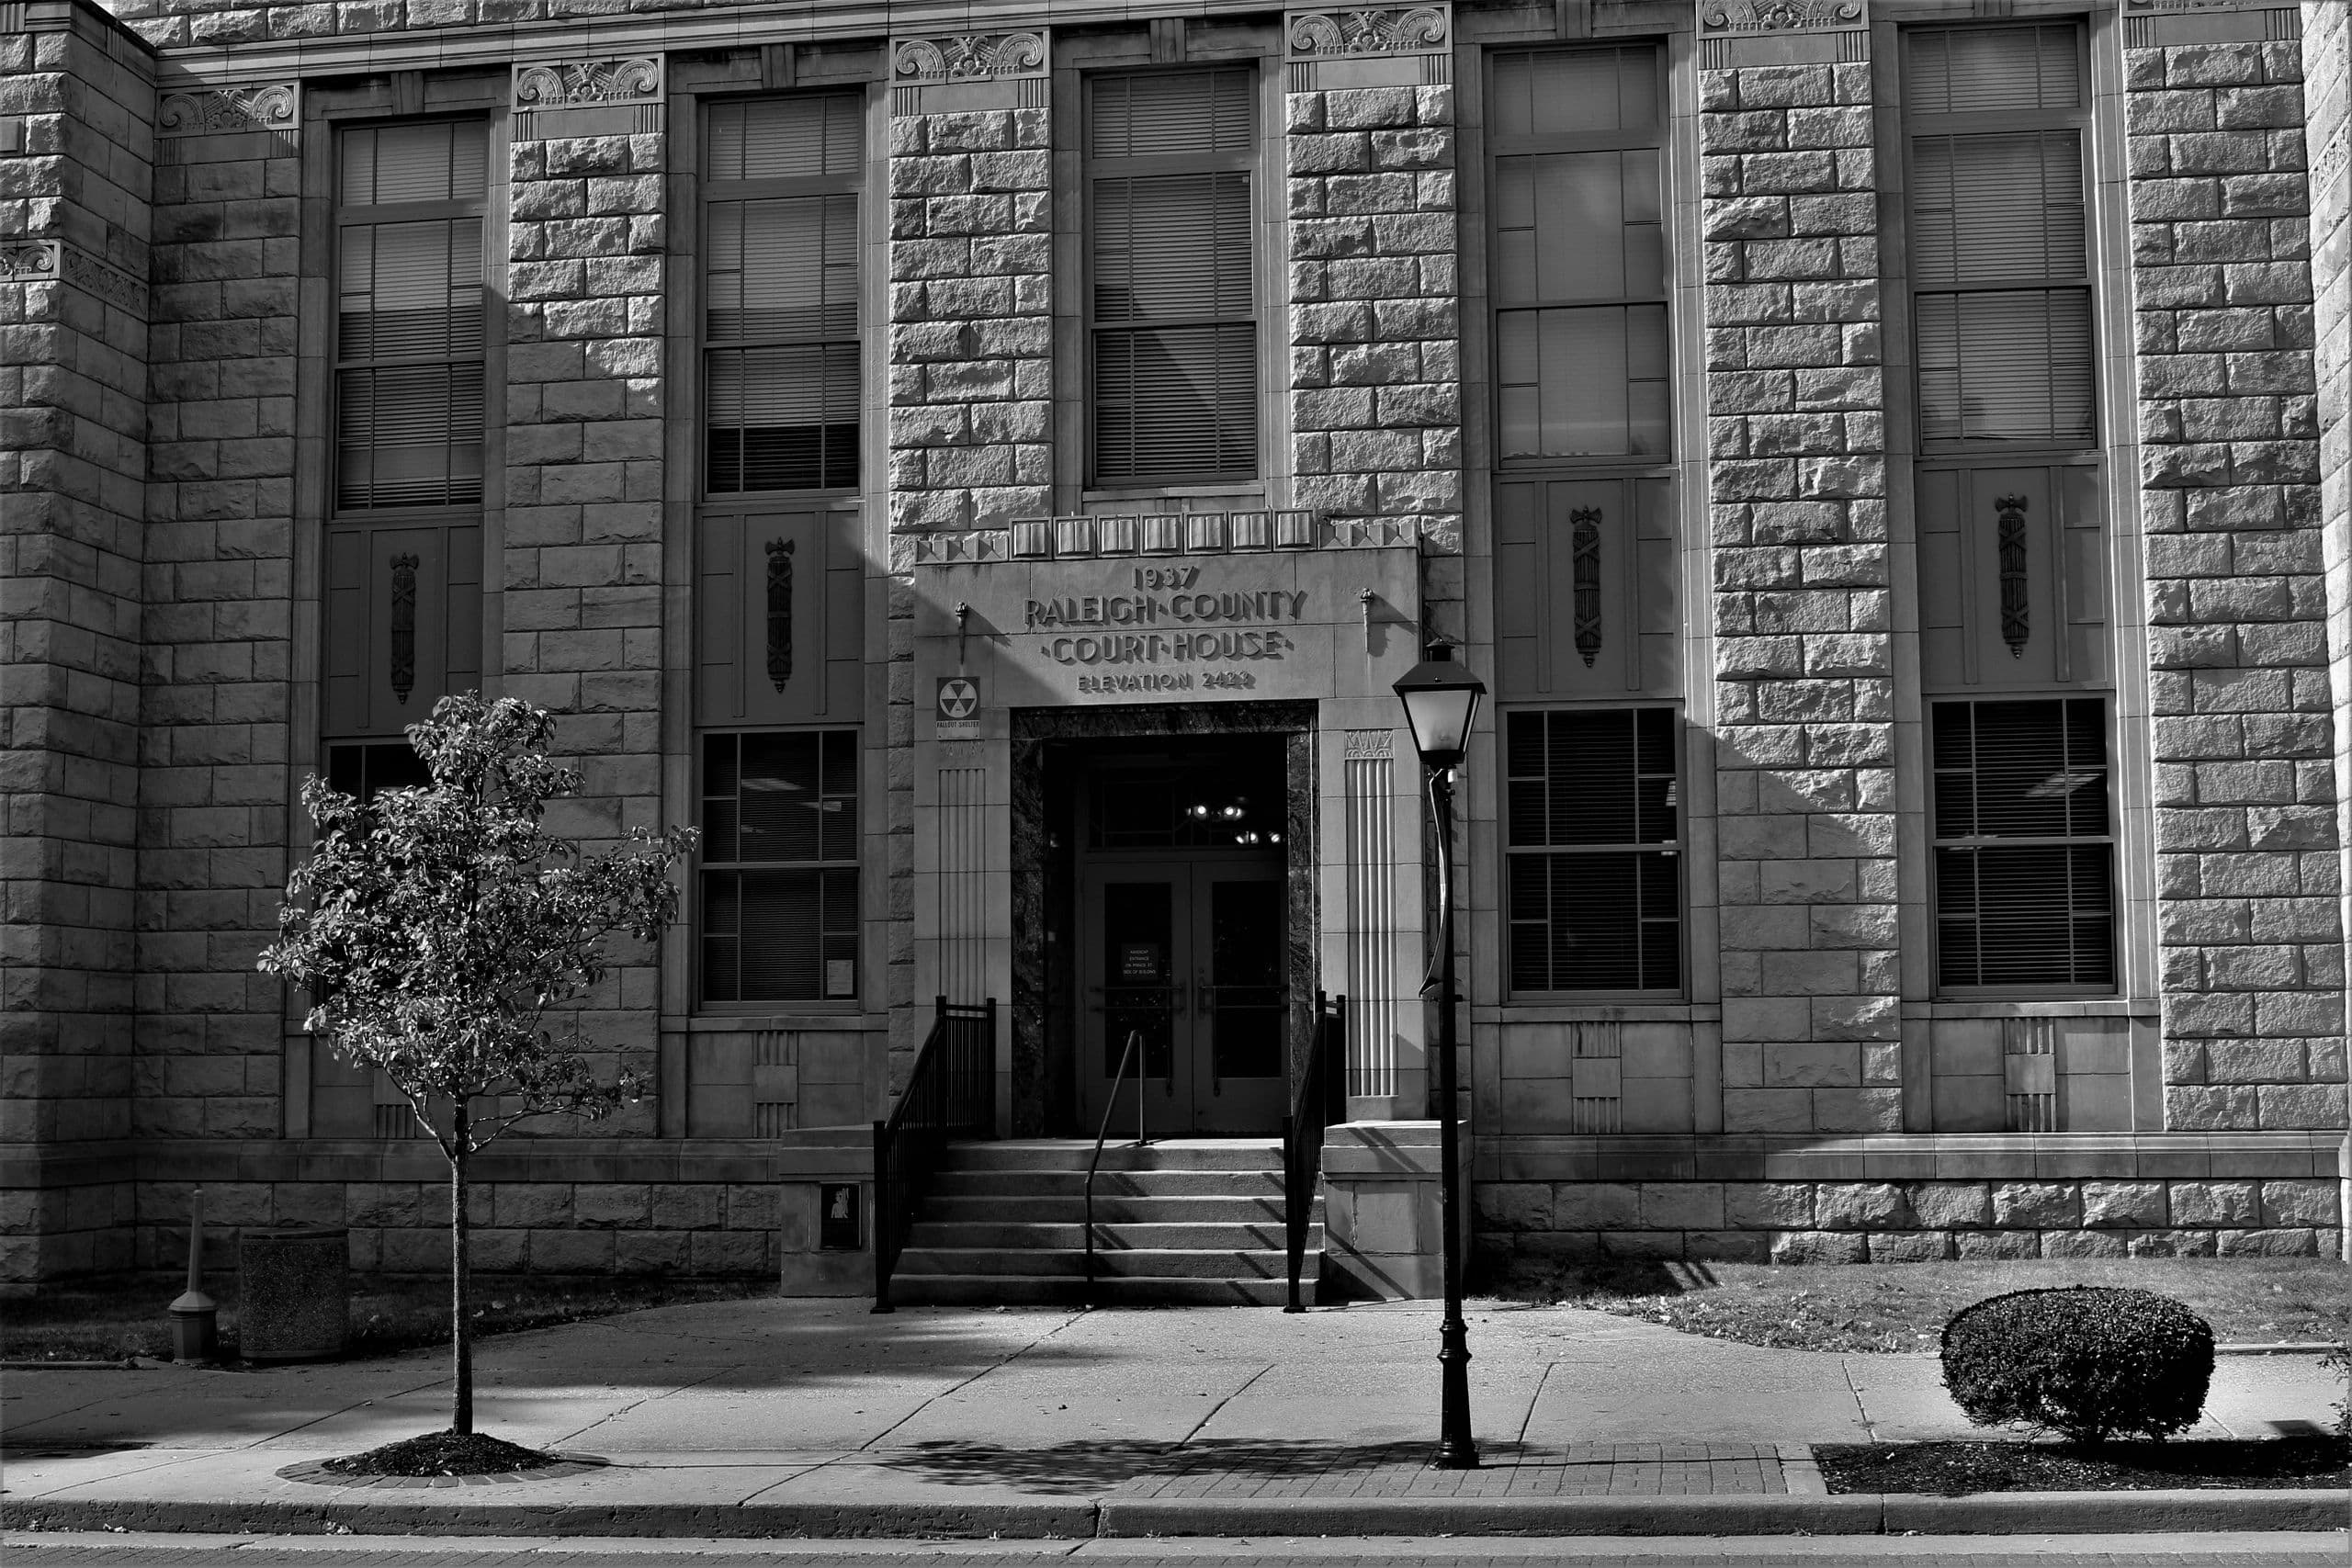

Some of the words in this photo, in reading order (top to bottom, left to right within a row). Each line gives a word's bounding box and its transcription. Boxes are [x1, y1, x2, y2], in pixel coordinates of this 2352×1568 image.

[1132, 566, 1196, 588] 1937
[1023, 595, 1154, 626] RALEIGH
[1168, 590, 1306, 620] COUNTY
[1051, 635, 1159, 663] COURT
[1172, 631, 1283, 660] HOUSE
[1078, 672, 1193, 691] ELEVATION
